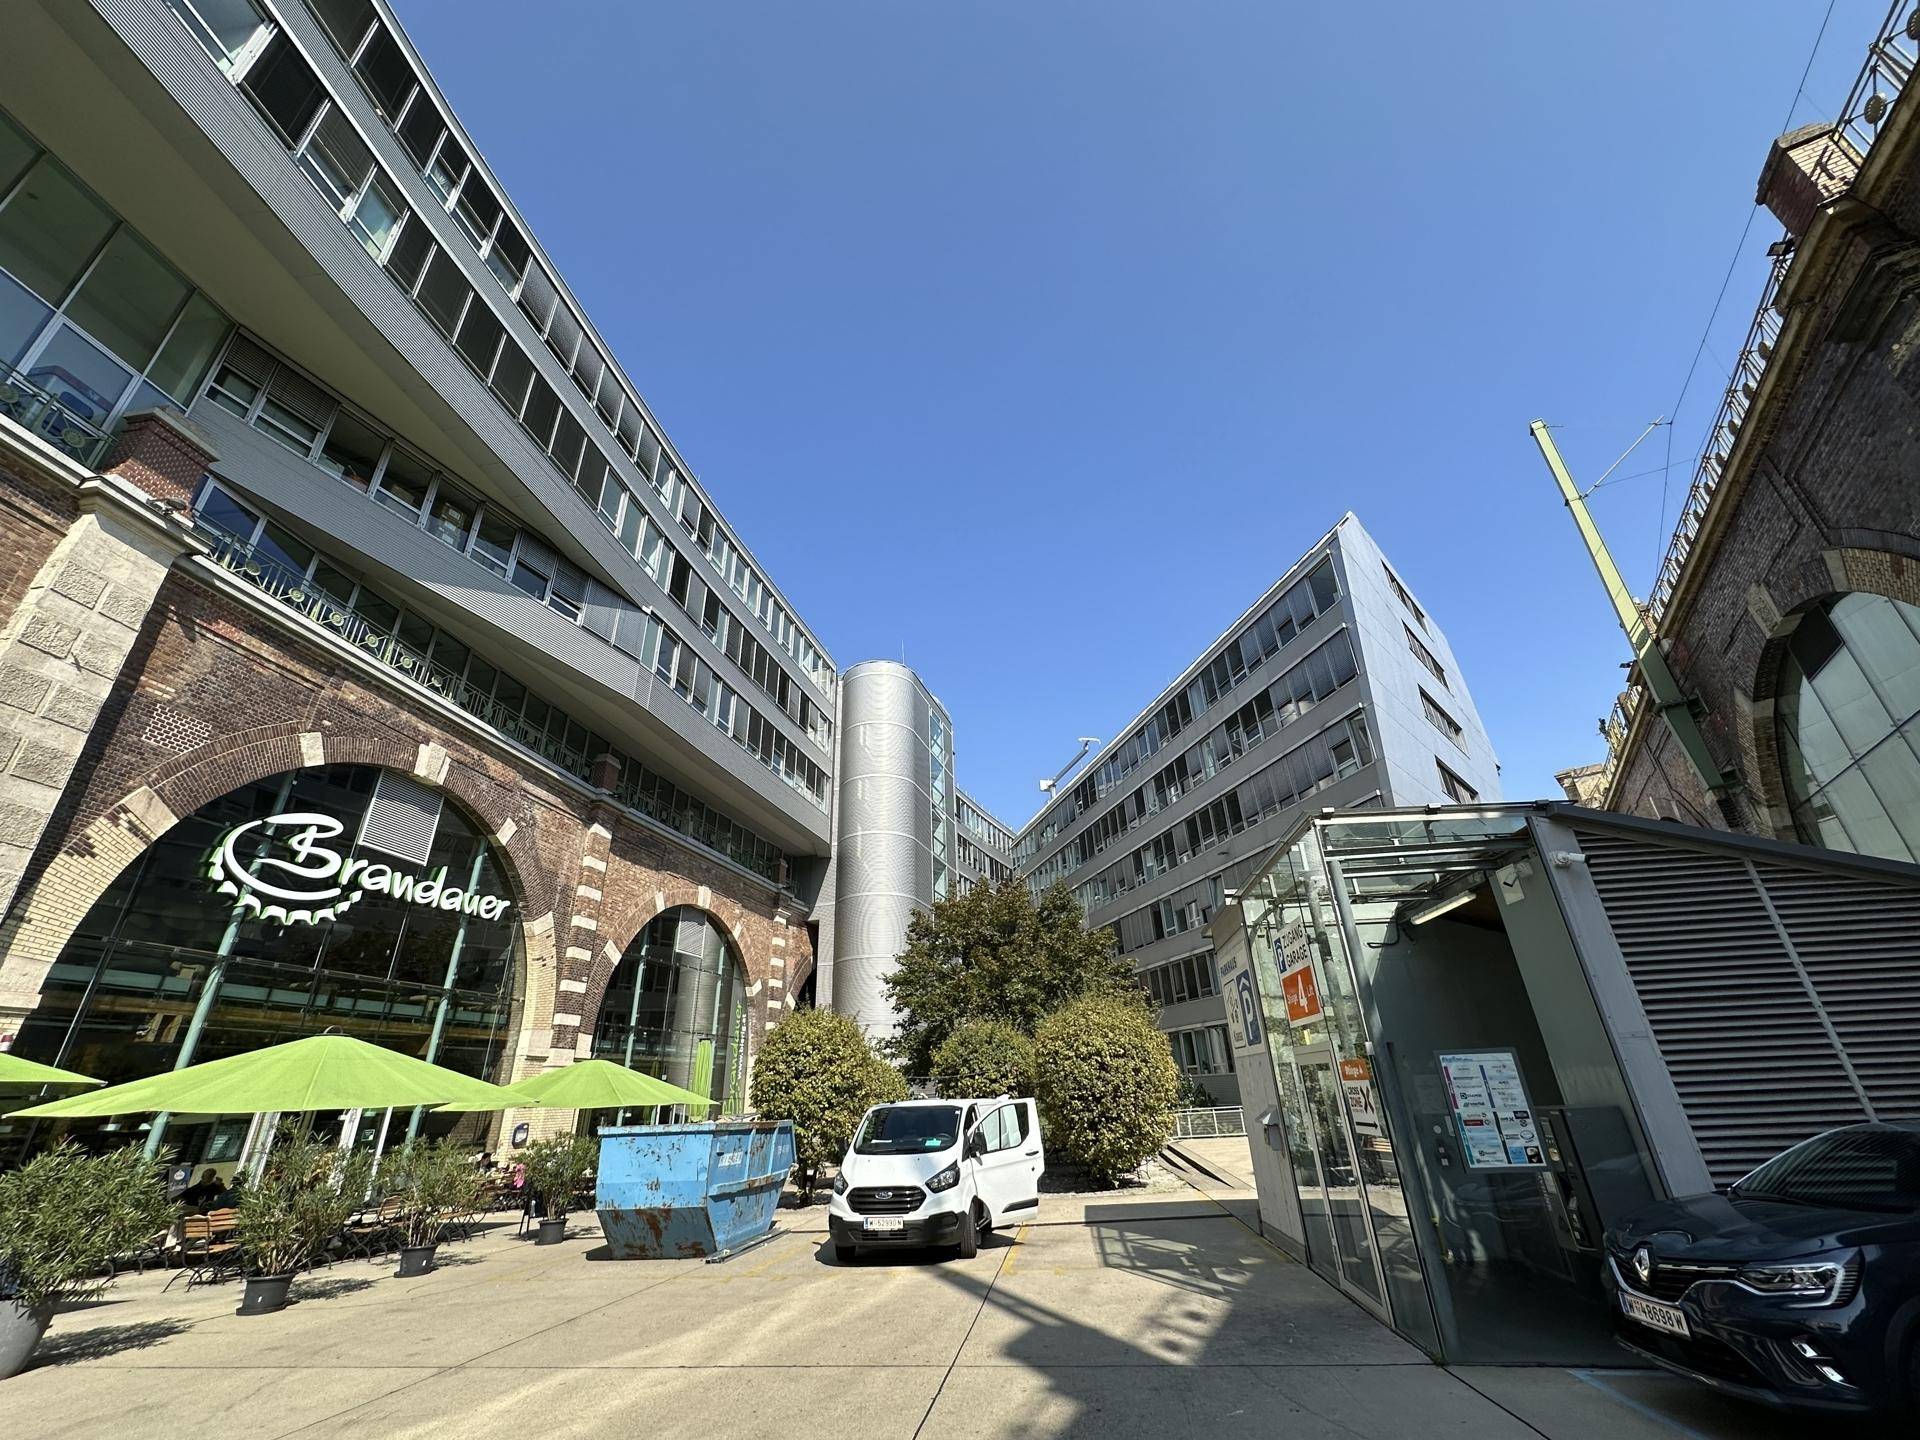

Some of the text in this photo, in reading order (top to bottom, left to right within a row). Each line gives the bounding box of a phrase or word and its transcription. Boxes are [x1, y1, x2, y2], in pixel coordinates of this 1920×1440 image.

[223, 812, 511, 921] Brandauer
[1282, 924, 1303, 949] ZUGANG
[1219, 956, 1238, 977] PARKHAUS
[1285, 943, 1308, 967] GARAGE
[1297, 974, 1309, 1013] 4
[723, 1000, 742, 1114] Brandauer
[1347, 1086, 1361, 1095] CROSS
[1349, 1096, 1364, 1108] ZONE
